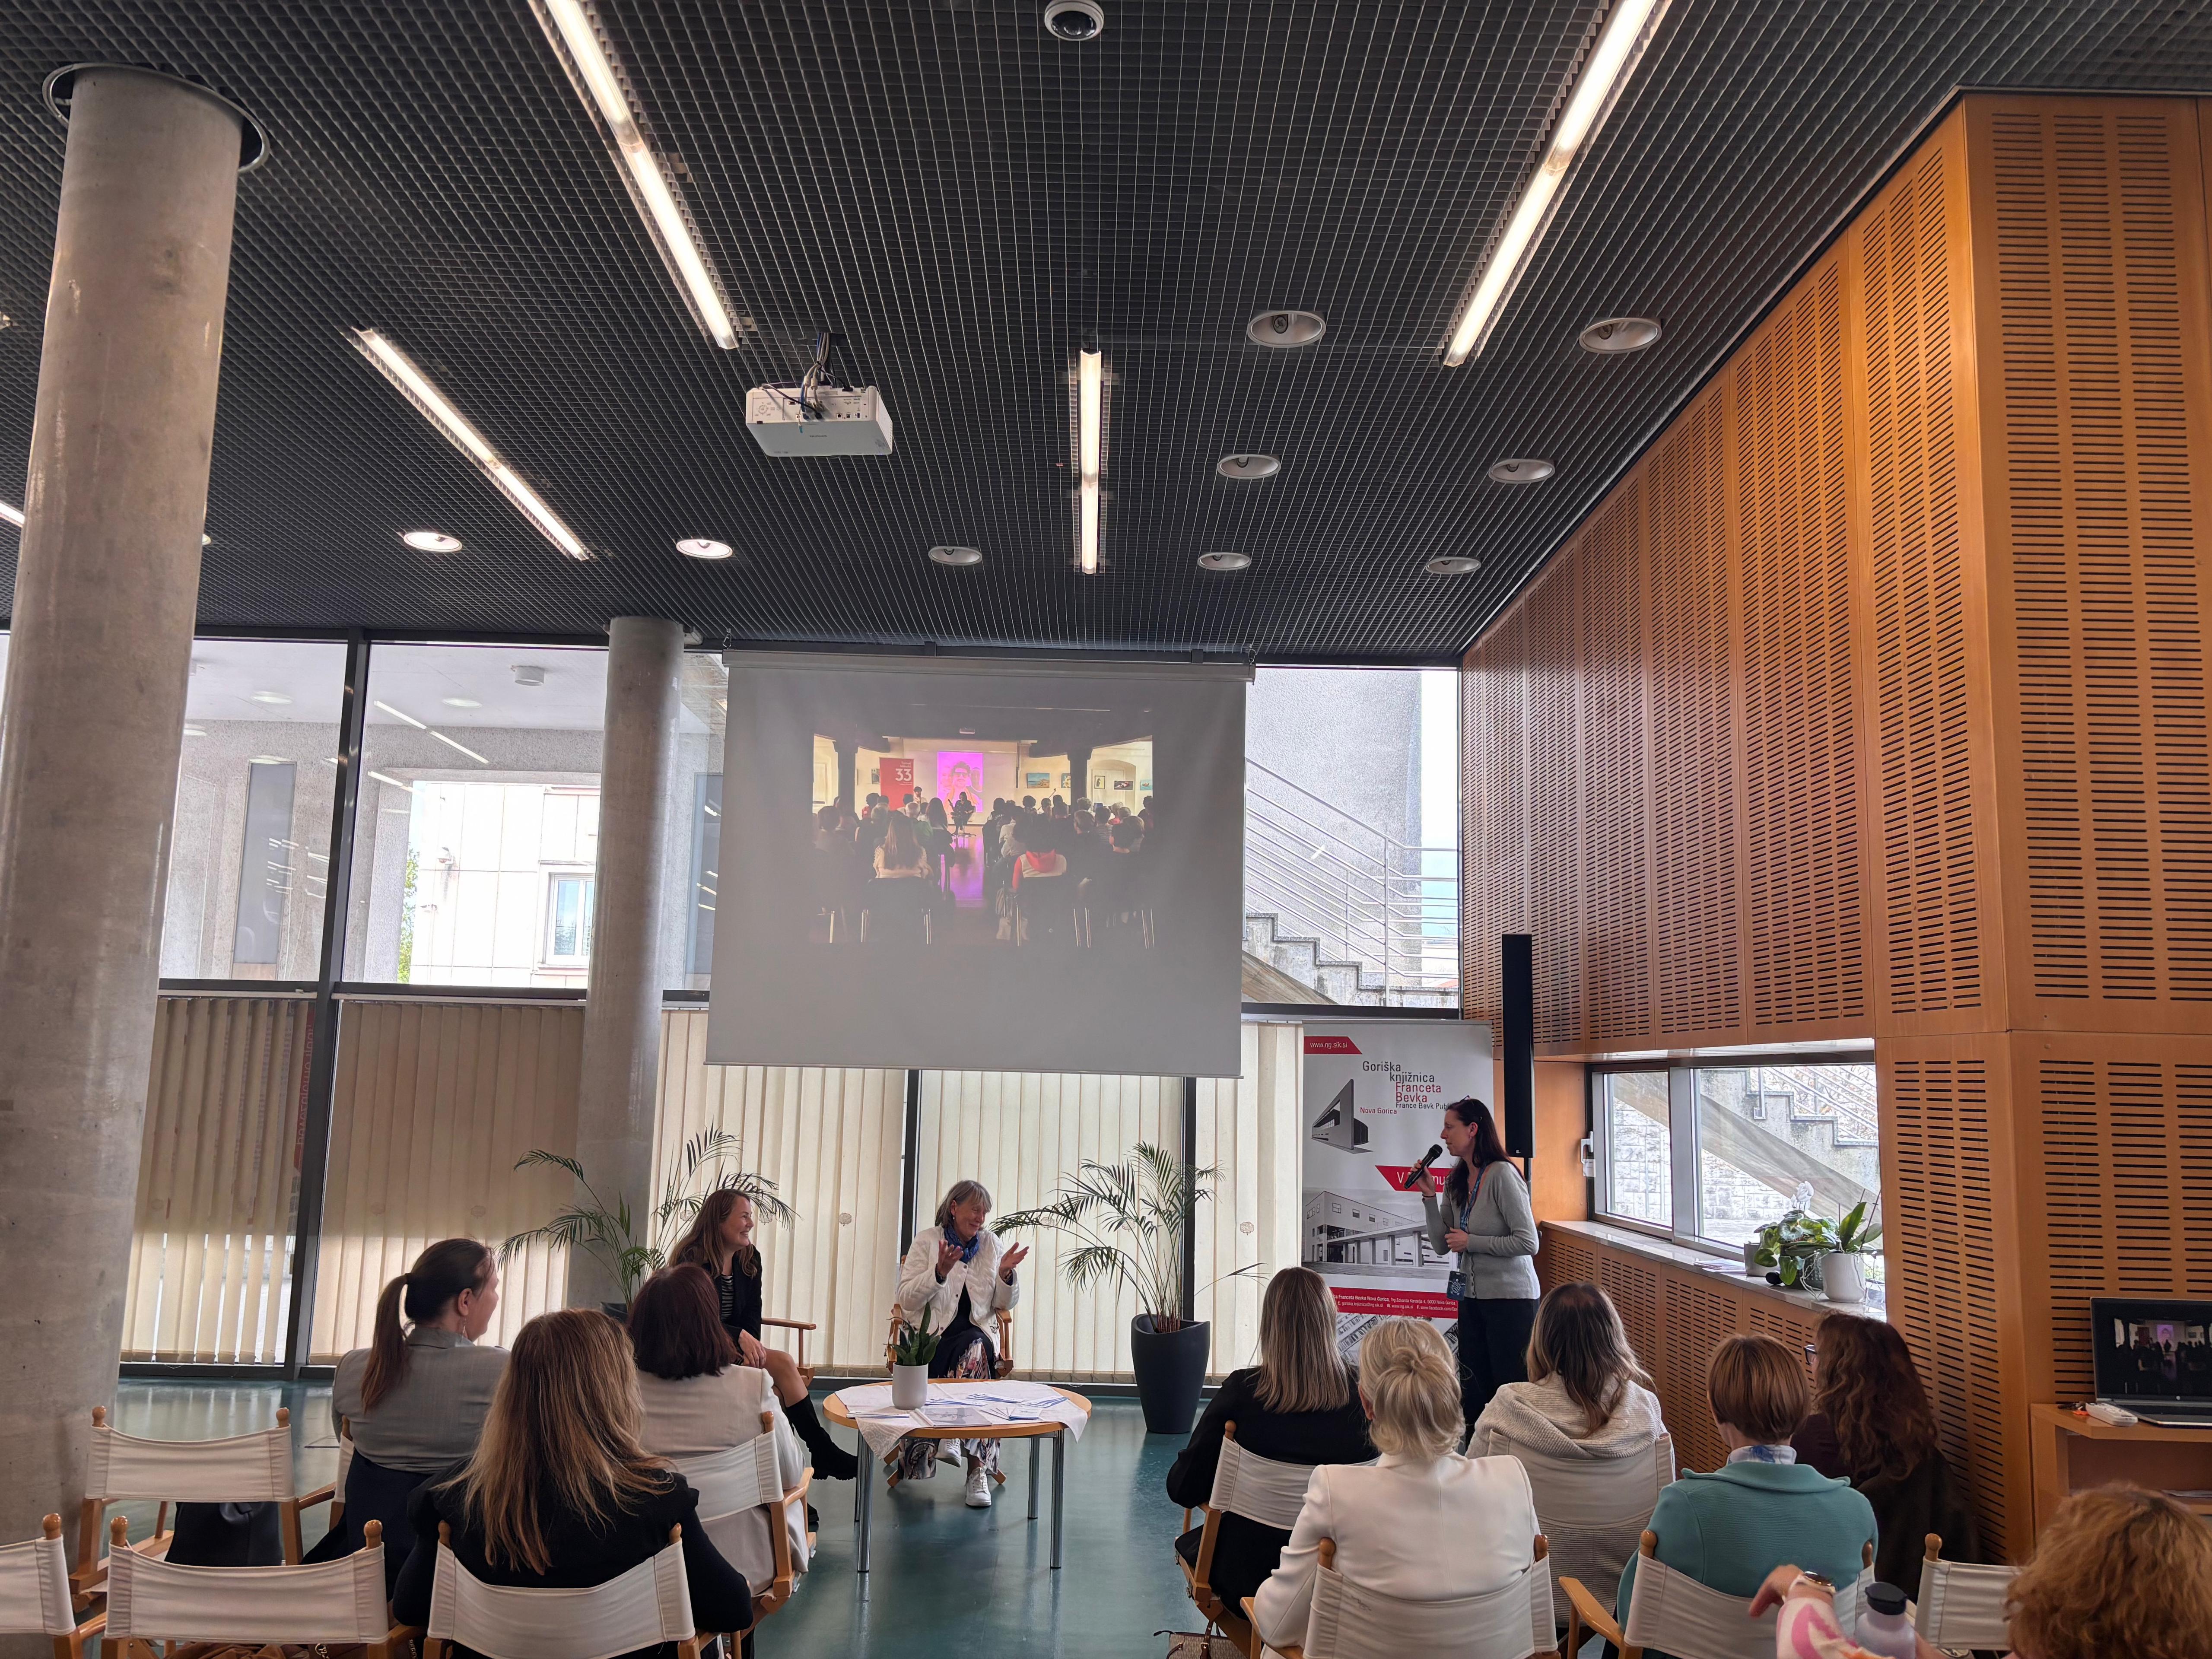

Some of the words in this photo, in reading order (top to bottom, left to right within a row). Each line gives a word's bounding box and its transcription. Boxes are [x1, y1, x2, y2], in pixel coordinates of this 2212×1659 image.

[895, 768, 912, 781] 33
[1363, 1061, 1401, 1072] Goriška
[1390, 1071, 1435, 1084] knjižnica
[1395, 1082, 1442, 1093] Franceta
[1395, 1092, 1427, 1103] Bevka
[1397, 1172, 1404, 1183] V
